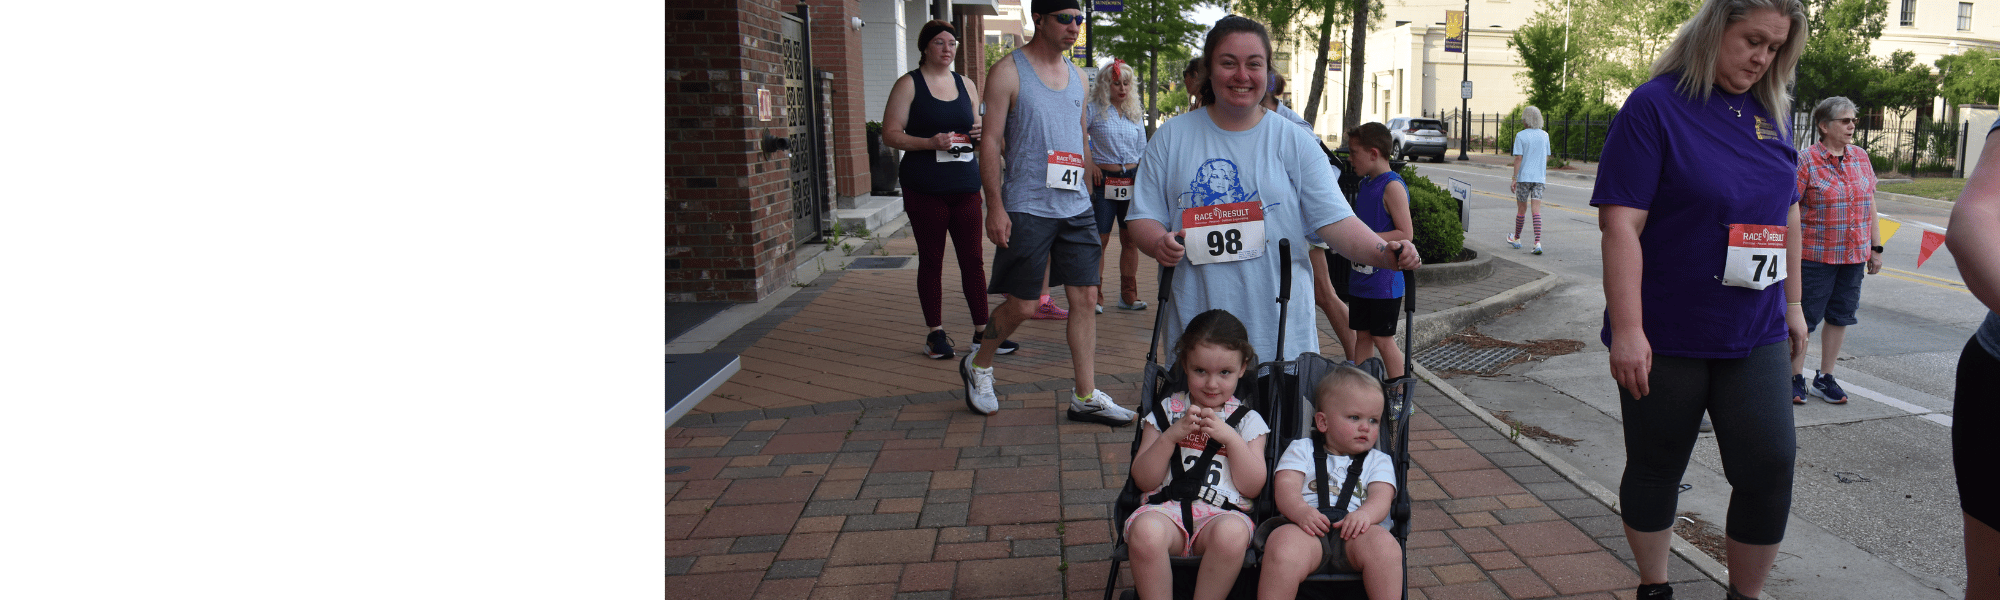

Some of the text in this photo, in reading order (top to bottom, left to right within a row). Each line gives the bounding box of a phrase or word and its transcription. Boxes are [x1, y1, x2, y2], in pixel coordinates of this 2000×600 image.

[1061, 169, 1078, 186] 41
[1114, 187, 1127, 198] 19
[1194, 212, 1213, 221] RACE
[1222, 208, 1249, 218] RESULT
[1206, 228, 1243, 257] 98
[1743, 232, 1784, 242] RACE RESULT
[1751, 254, 1778, 282] 74
